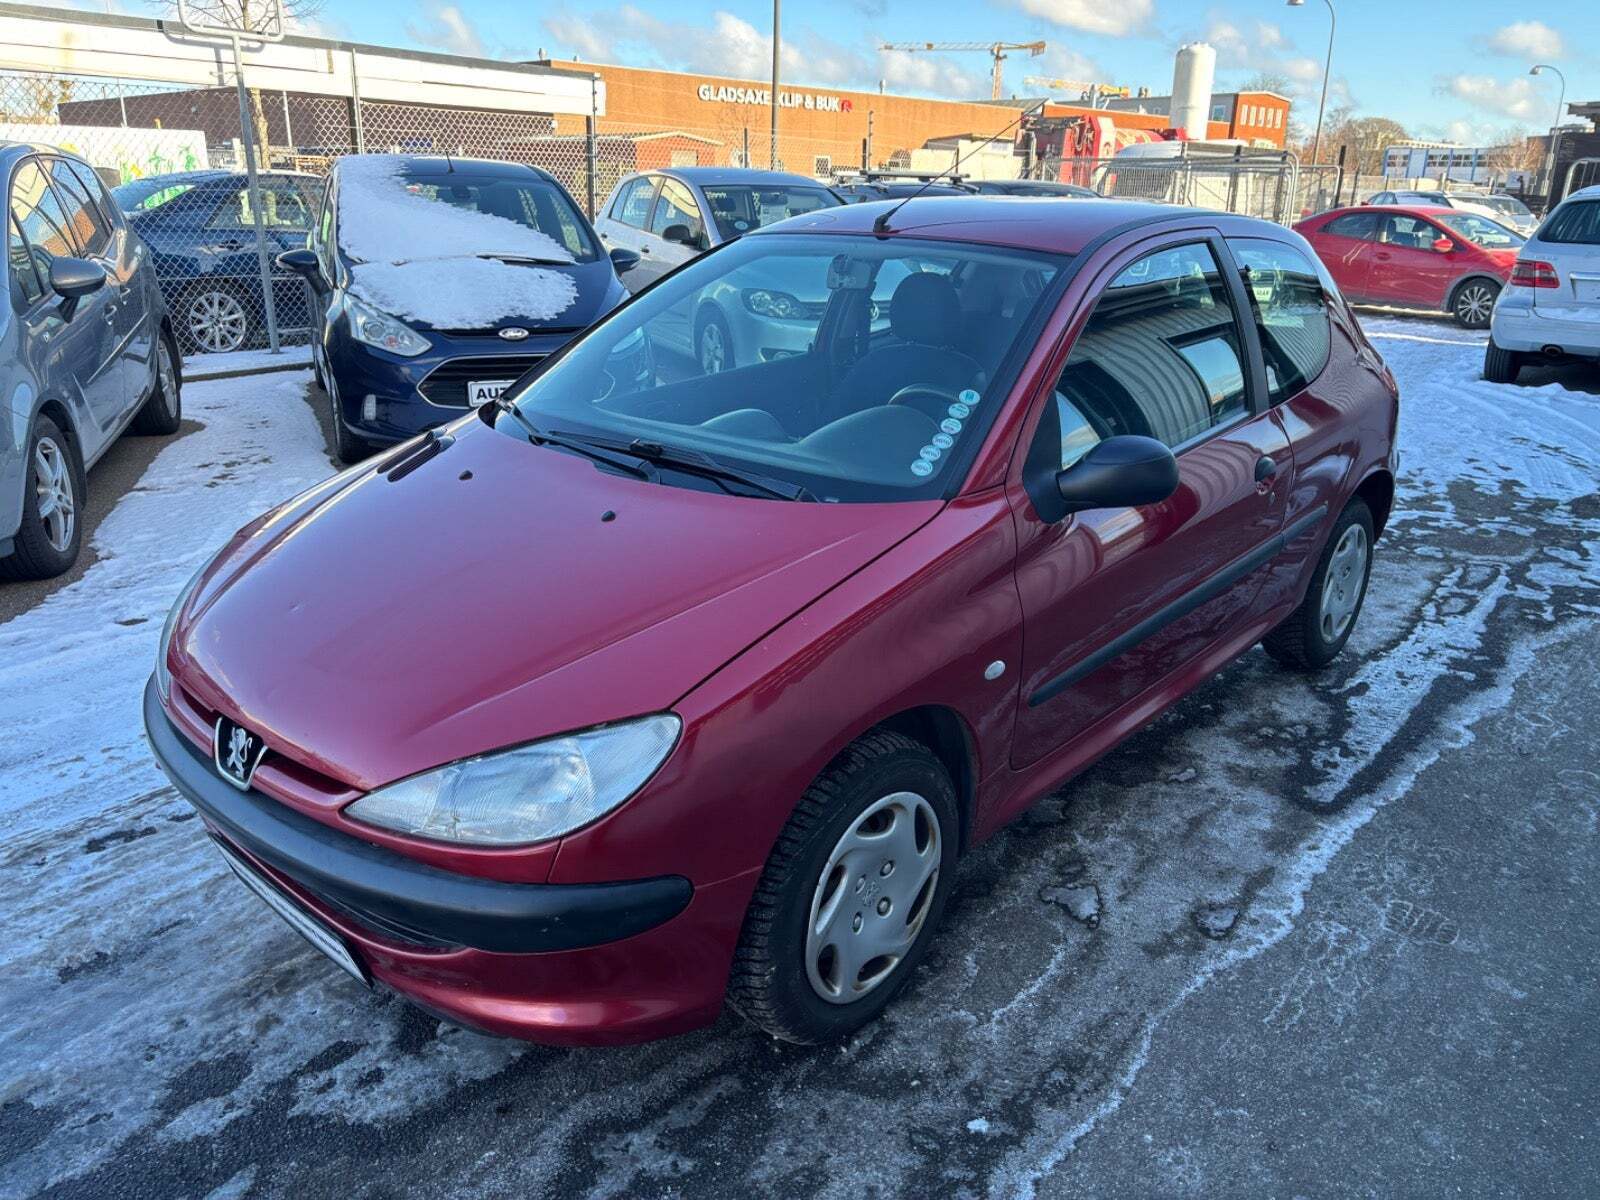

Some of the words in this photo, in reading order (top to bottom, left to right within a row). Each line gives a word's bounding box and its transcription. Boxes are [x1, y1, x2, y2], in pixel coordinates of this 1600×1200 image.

[698, 84, 770, 105] GLADSAXE
[804, 94, 815, 110] &
[816, 95, 840, 112] BUK
